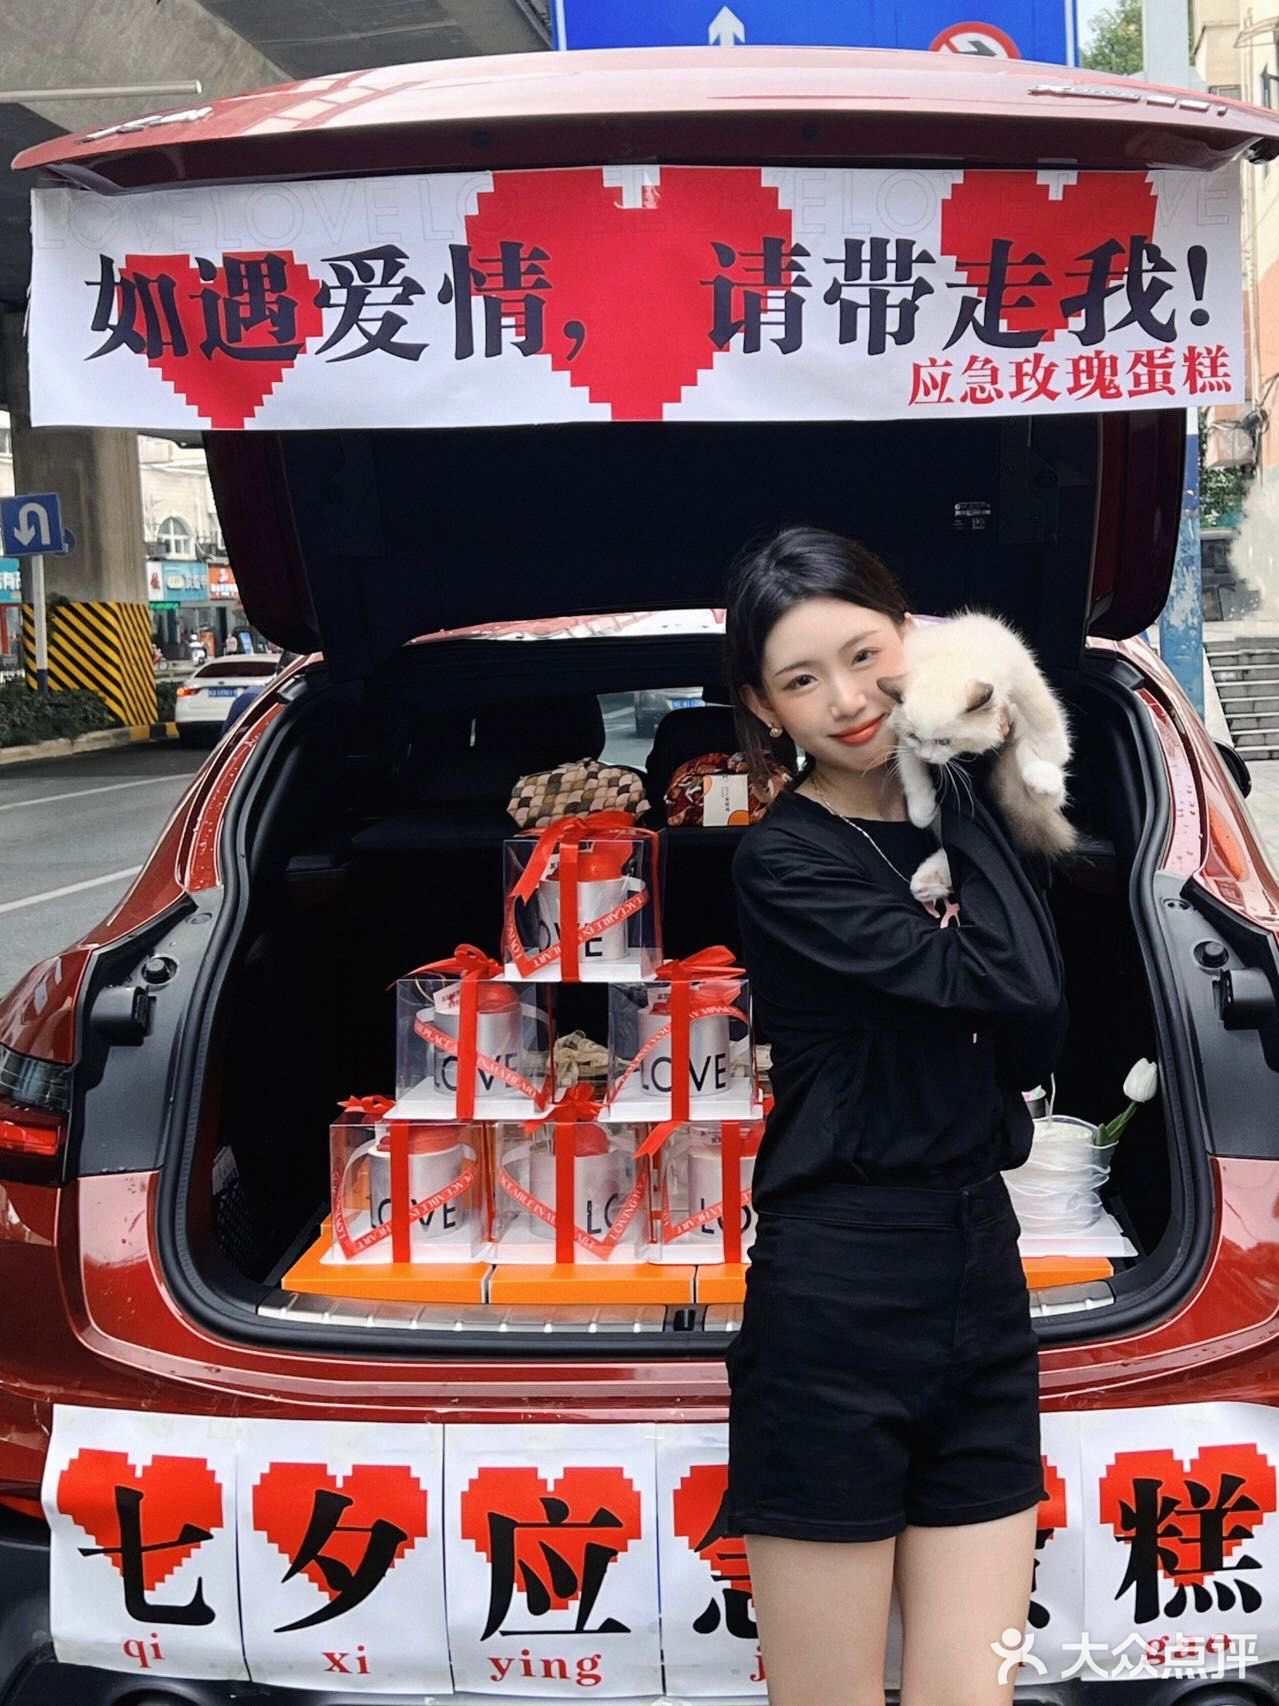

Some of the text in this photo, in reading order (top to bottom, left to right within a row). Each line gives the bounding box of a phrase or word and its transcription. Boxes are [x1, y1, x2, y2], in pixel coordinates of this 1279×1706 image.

[908, 345, 1233, 408] 应急玫瑰蛋糕
[79, 1486, 215, 1626] 七
[274, 1489, 408, 1633] 夕
[481, 1497, 631, 1642] 应
[1114, 1473, 1263, 1625] 糕
[123, 1632, 163, 1668] qi
[325, 1645, 368, 1675] xi
[489, 1652, 602, 1687] ying
